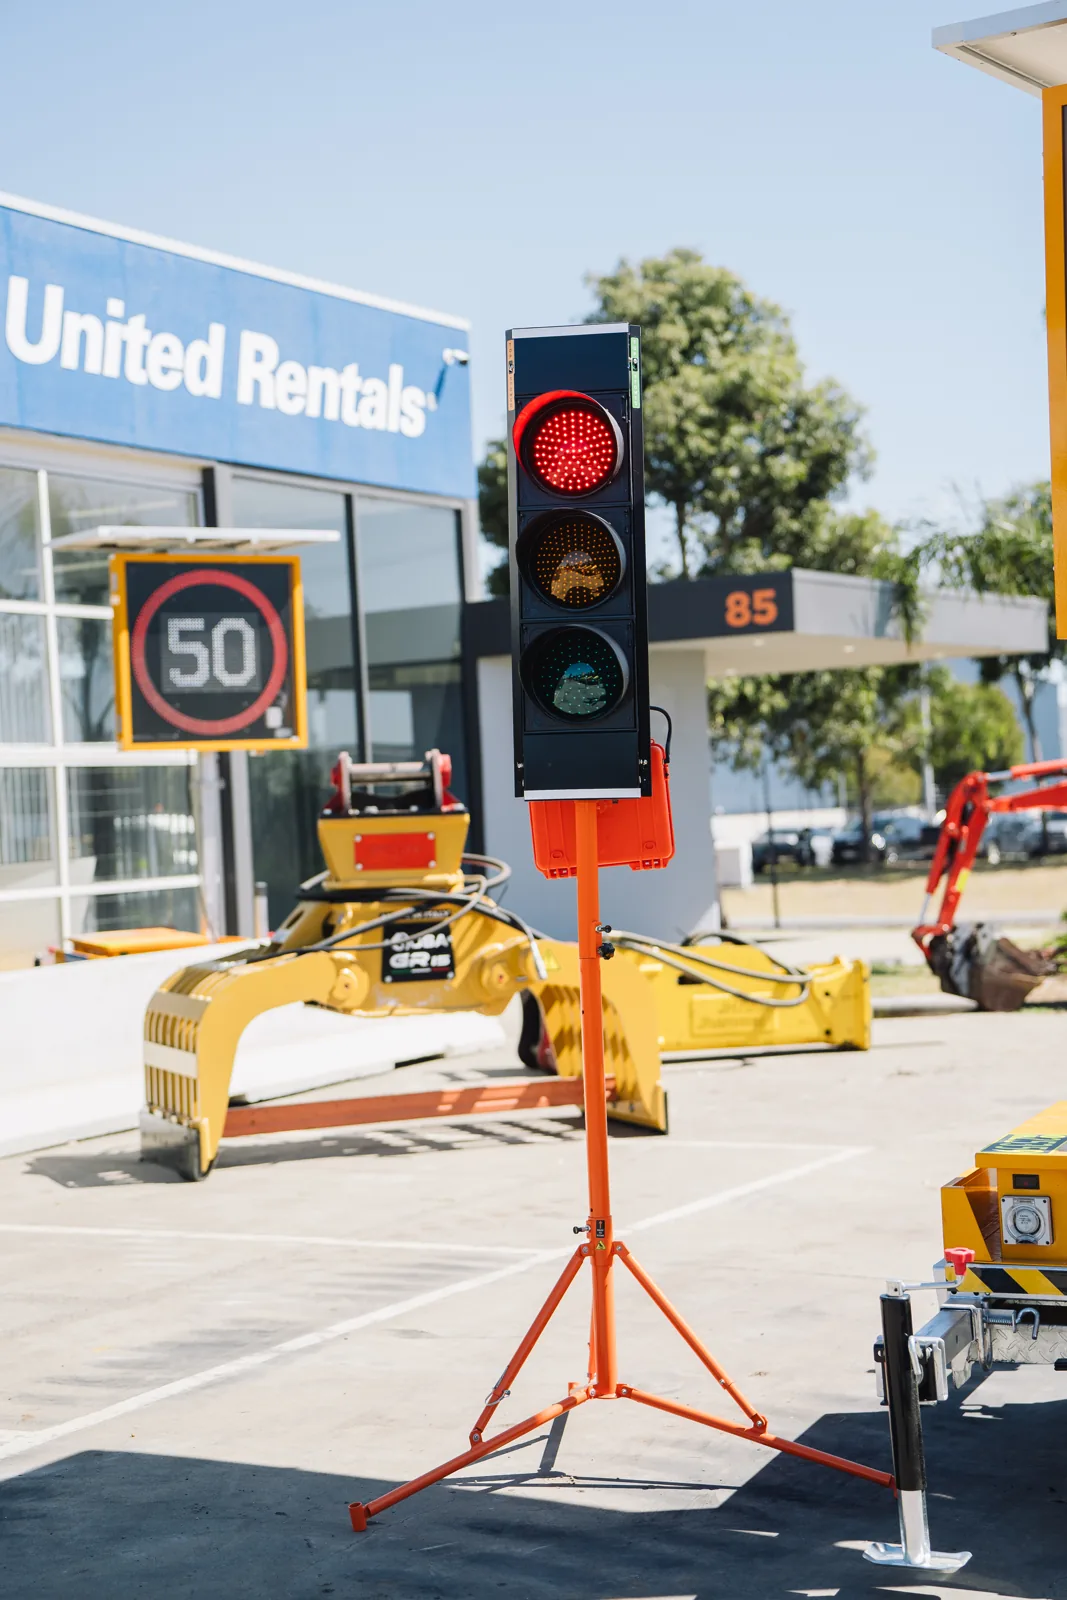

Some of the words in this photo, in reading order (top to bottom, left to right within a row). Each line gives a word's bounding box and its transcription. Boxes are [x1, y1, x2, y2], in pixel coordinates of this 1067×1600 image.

[5, 275, 226, 399] United
[237, 329, 427, 438] Rentals
[725, 588, 778, 628] 85
[168, 617, 256, 687] 50
